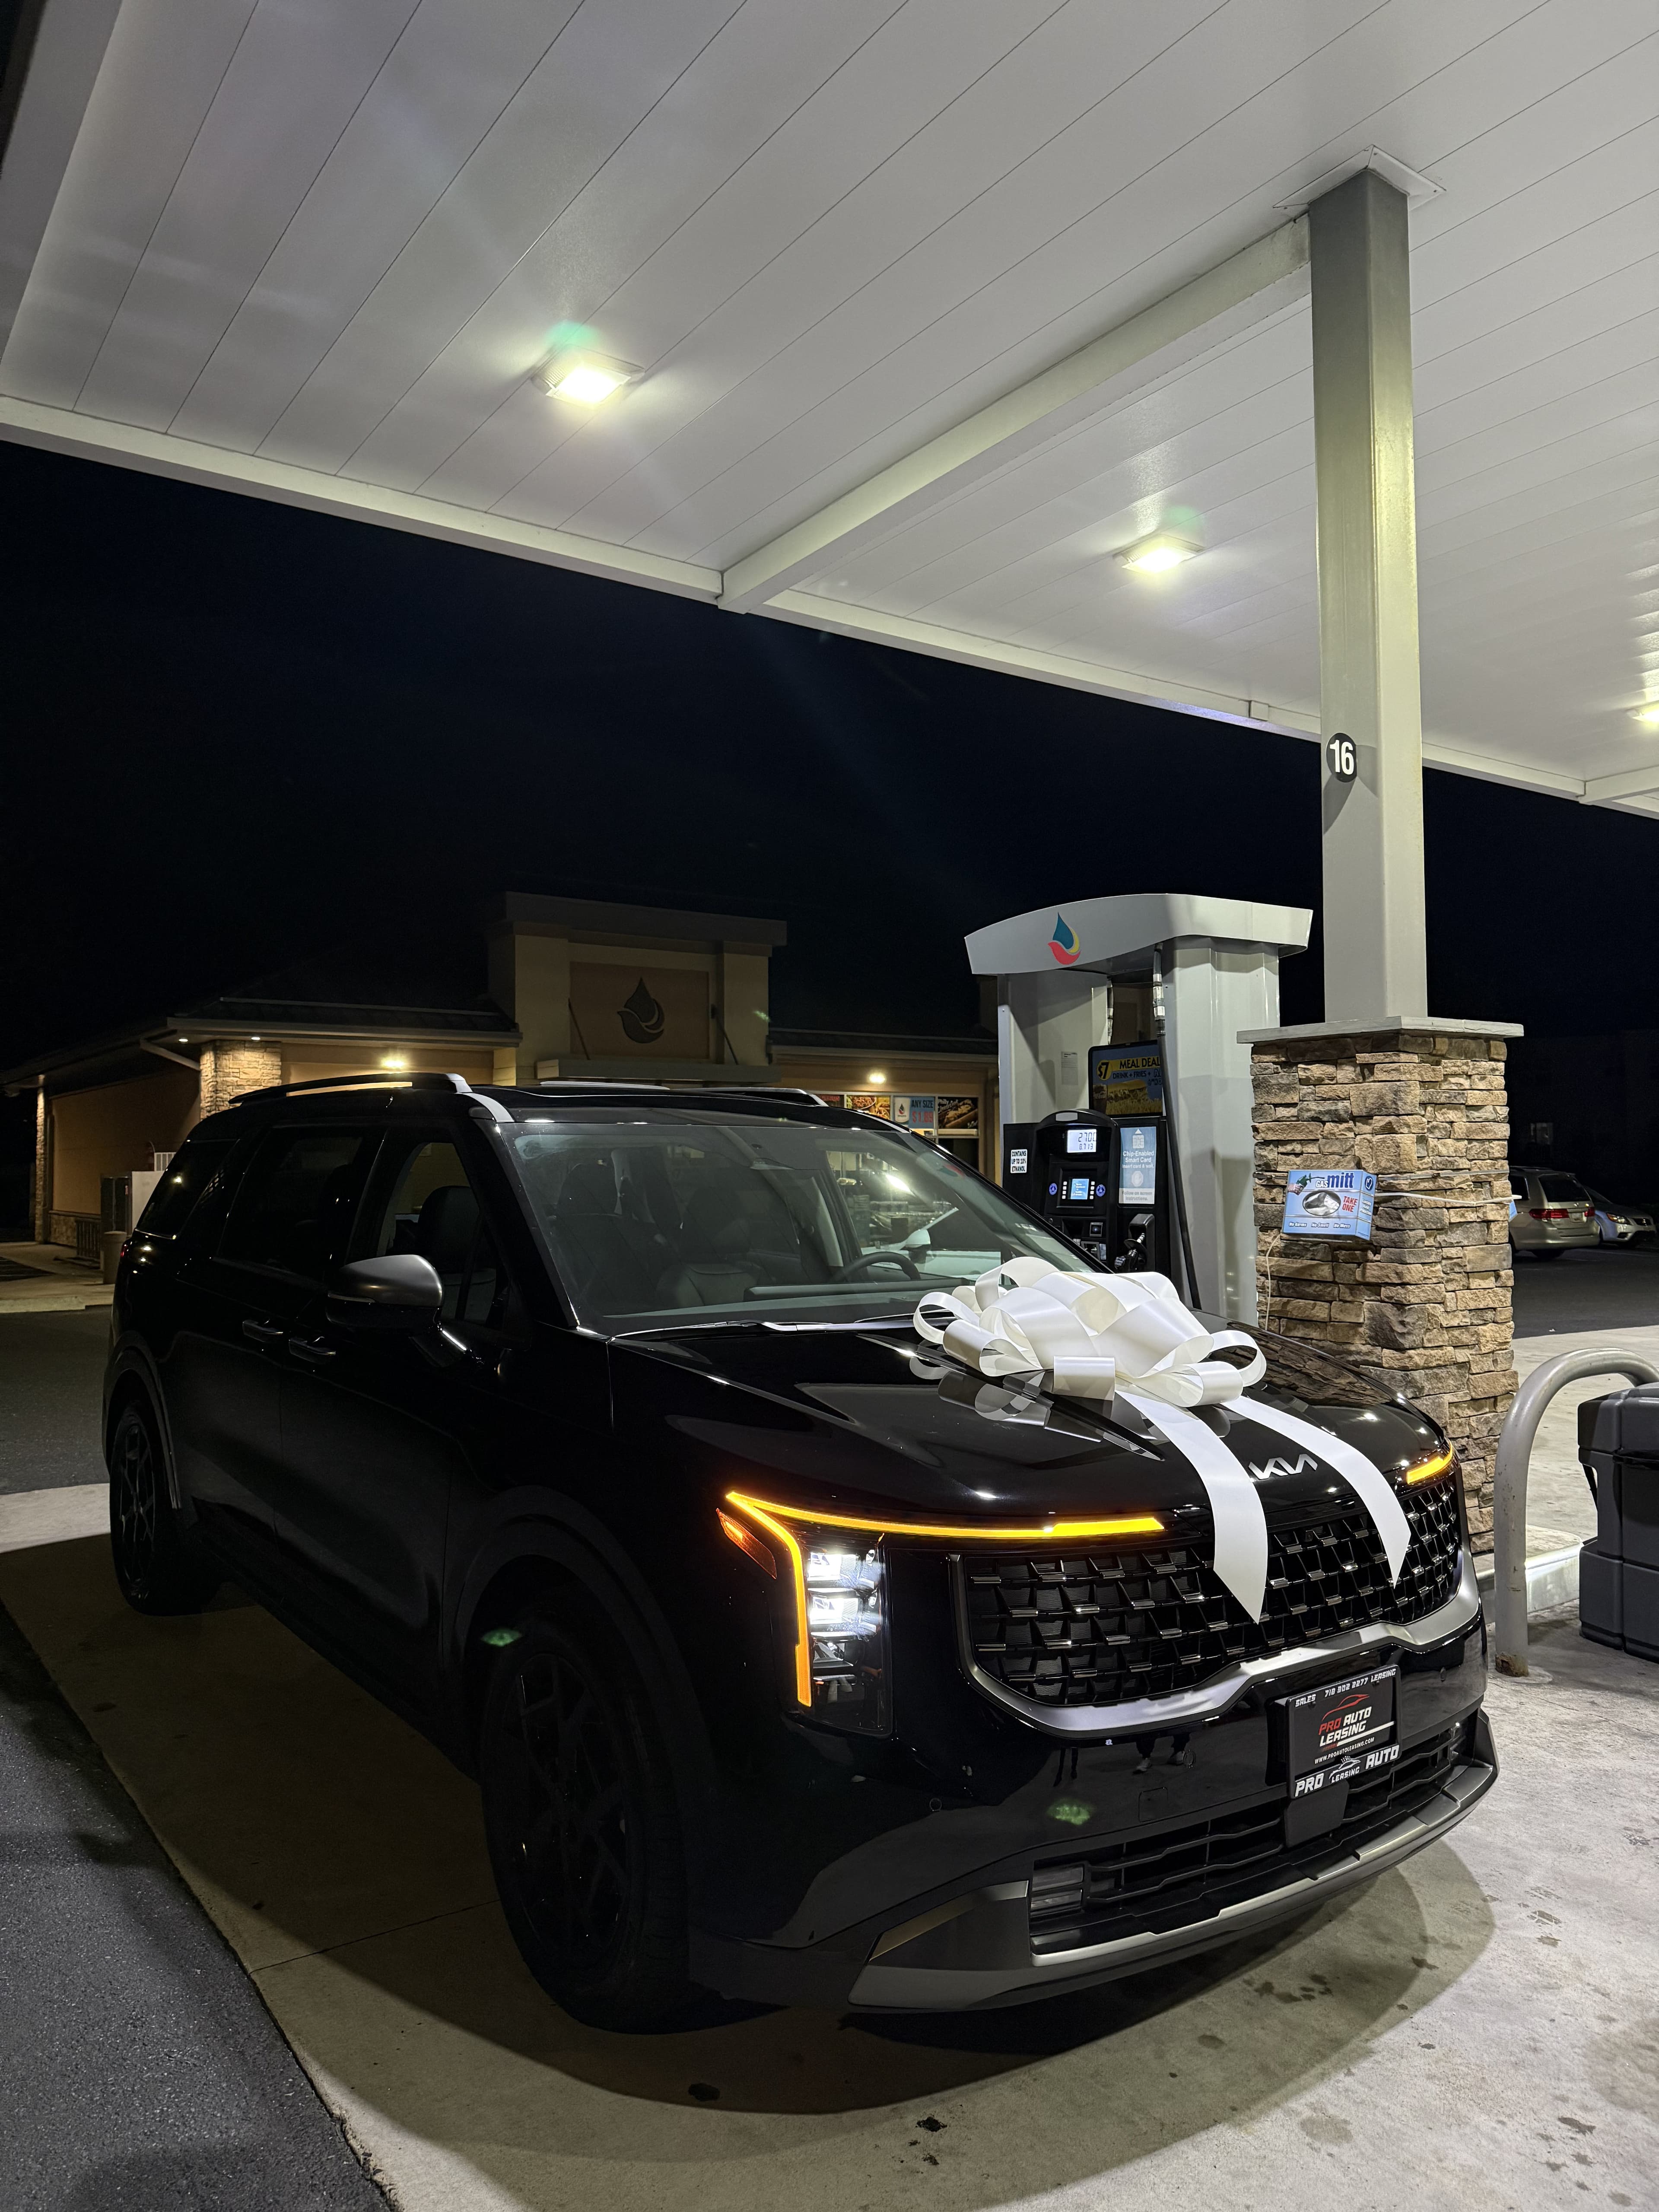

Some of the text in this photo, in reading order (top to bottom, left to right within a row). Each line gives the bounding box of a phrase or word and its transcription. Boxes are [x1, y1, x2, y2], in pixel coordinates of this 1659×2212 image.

[1329, 739, 1354, 775] 16
[1098, 1057, 1160, 1079] $7 MEAL DEAL
[912, 1100, 922, 1108] ANY
[923, 1100, 934, 1108] SIZE
[1316, 1172, 1354, 1189] GAS mitt
[1342, 1203, 1355, 1212] ONE
[1343, 1195, 1358, 1205] TAKE
[1248, 1453, 1318, 1480] KIA
[1295, 1694, 1316, 1707] SALES
[1352, 1677, 1369, 1689] 2277
[1370, 1668, 1396, 1683] LEASING
[1318, 1706, 1372, 1735] PRO AUTO
[1319, 1720, 1367, 1747] LEASING
[1314, 1737, 1375, 1764] WWW.PROAUTOLEASING.COM
[1295, 1744, 1400, 1797] PRO LEASING AUTO
